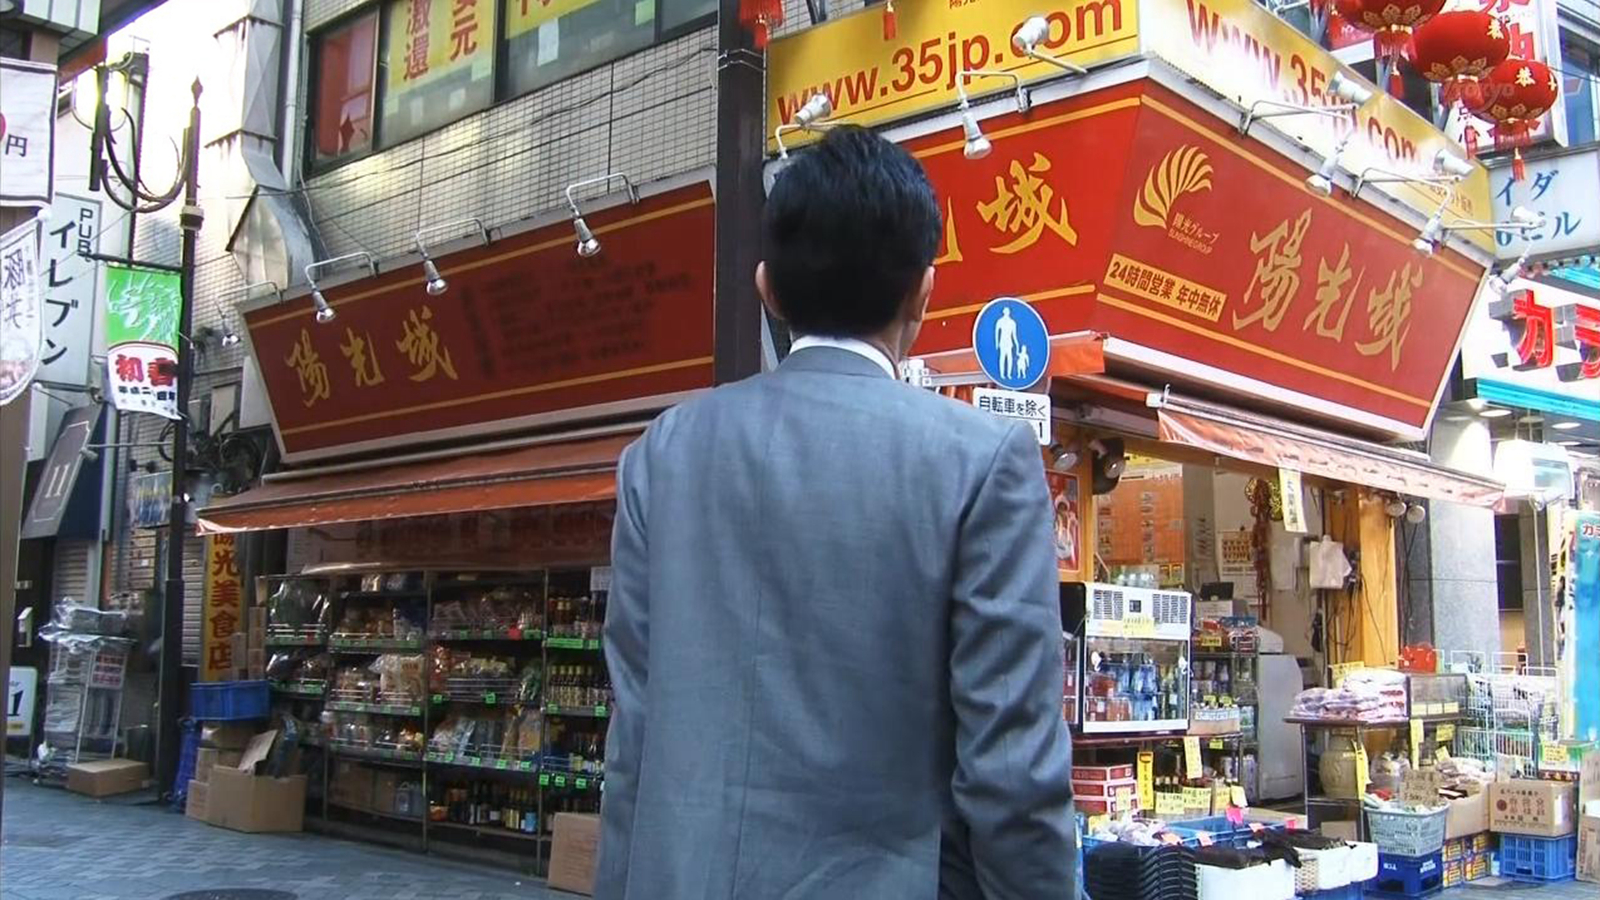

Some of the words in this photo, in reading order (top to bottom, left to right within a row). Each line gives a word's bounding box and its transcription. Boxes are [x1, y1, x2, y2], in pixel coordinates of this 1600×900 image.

[1514, 66, 1536, 87] 恭
[5, 133, 28, 158] 円
[42, 220, 79, 366] イレブン
[1109, 261, 1176, 300] 24時間営業
[1176, 285, 1221, 316] 年中無休
[1233, 207, 1424, 372] 陽光城
[286, 304, 458, 408] 陽光城
[979, 395, 1047, 418] 自転車を除く
